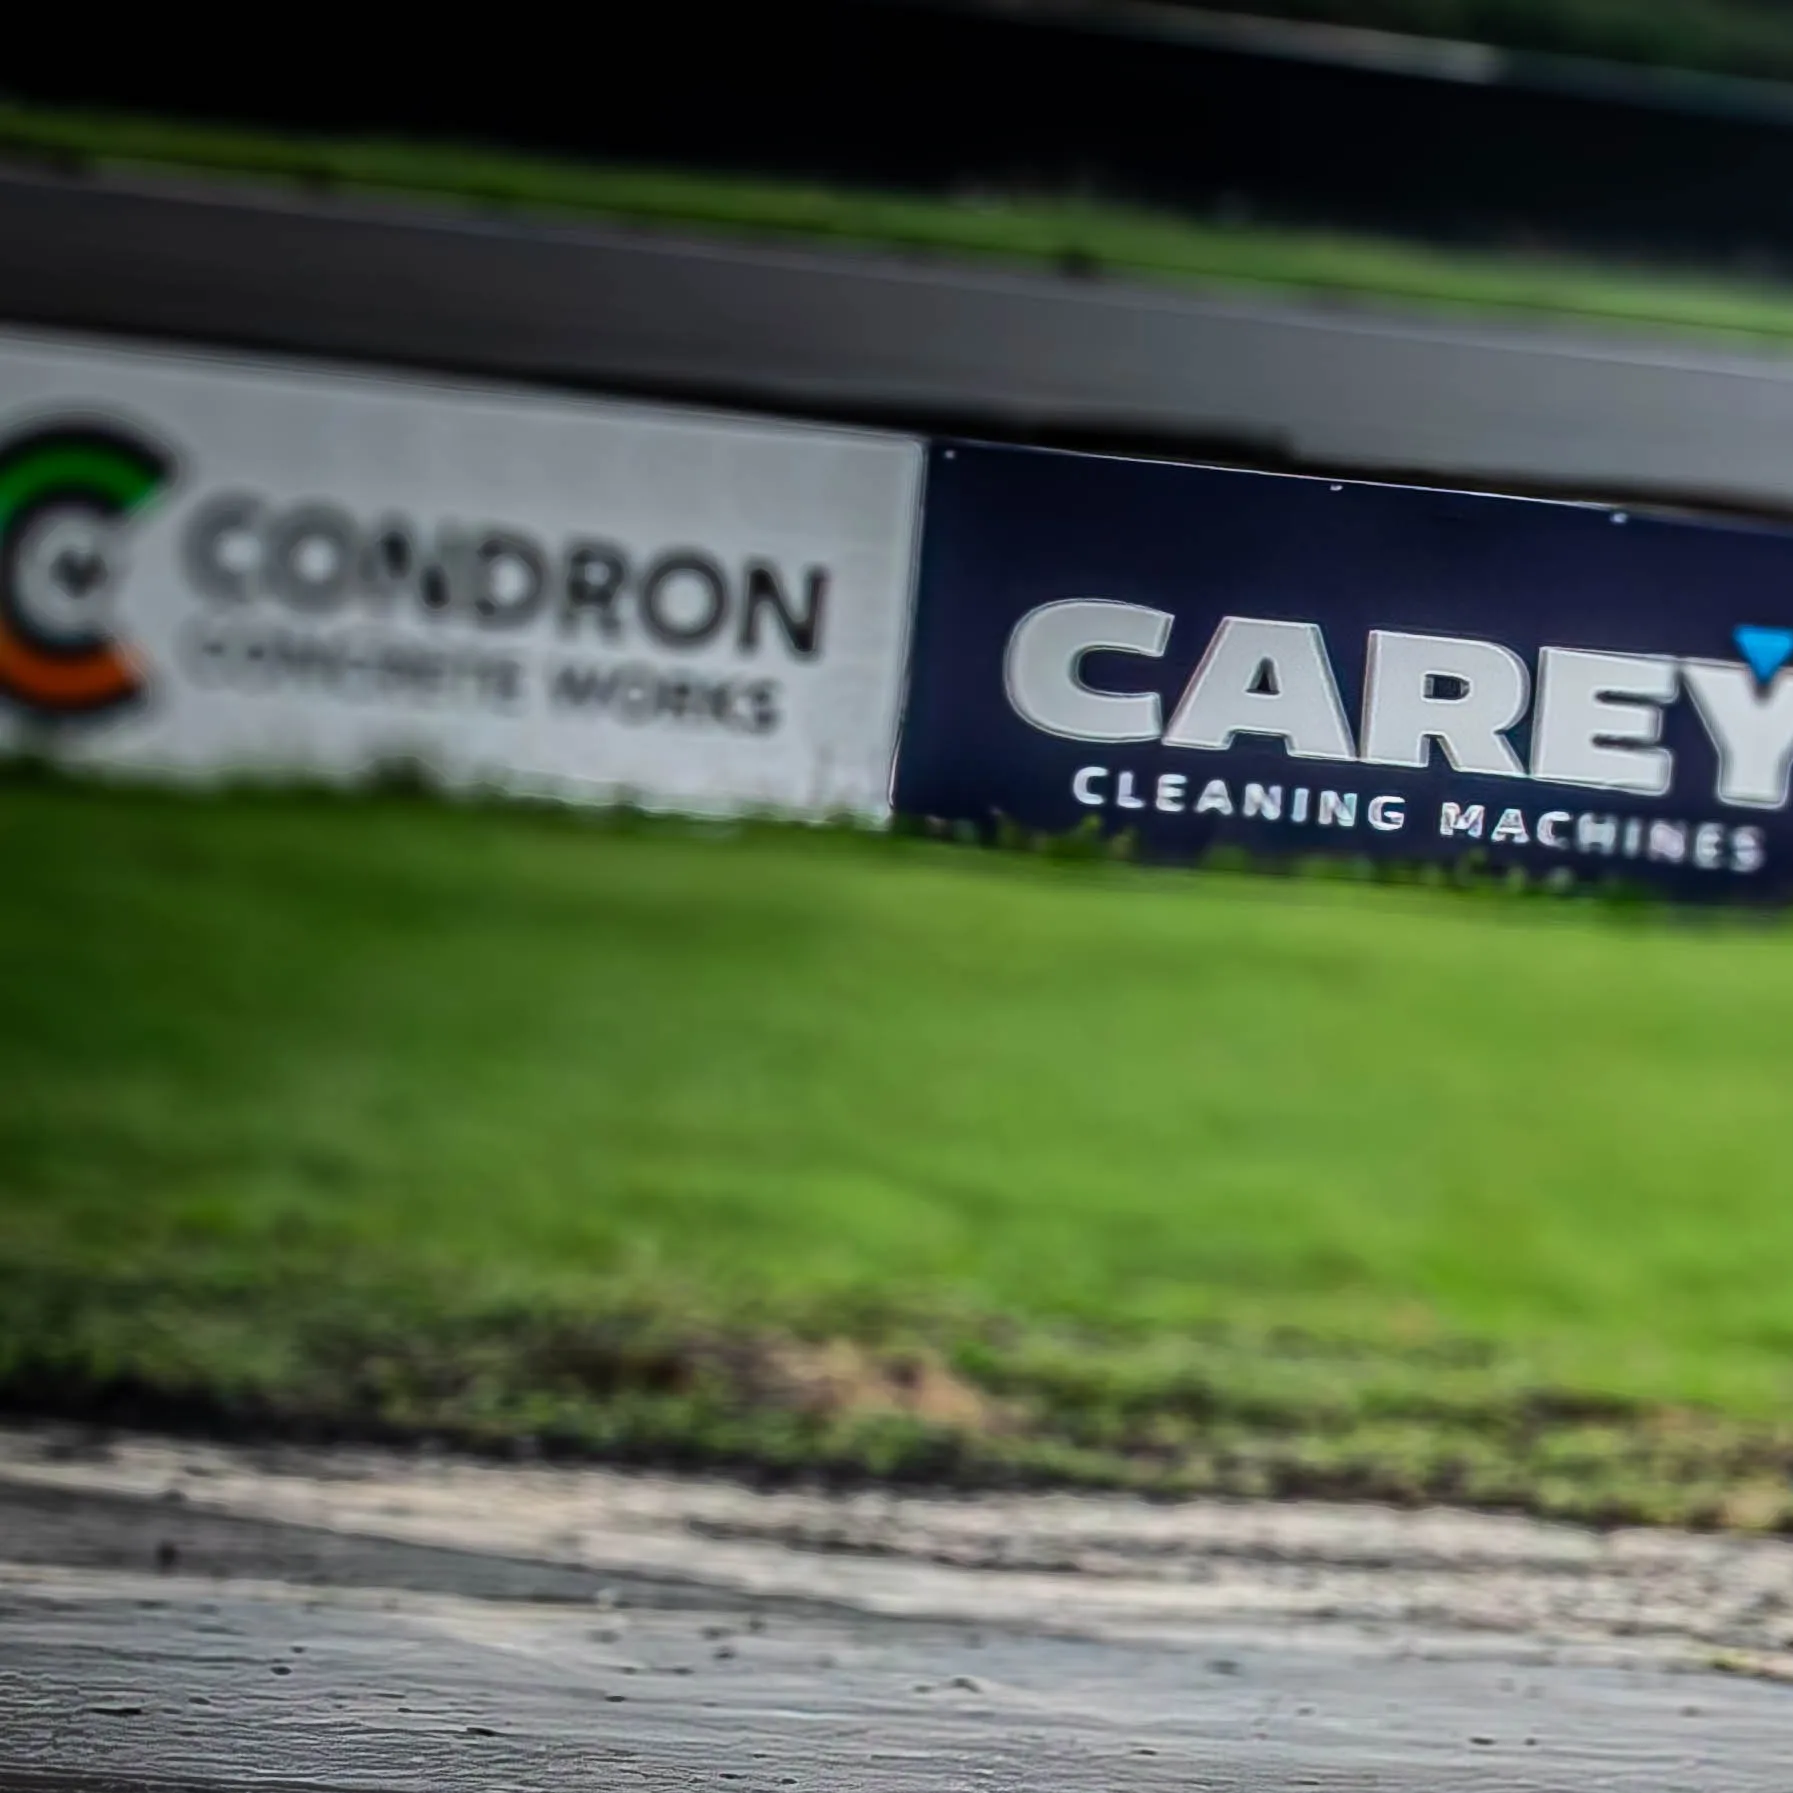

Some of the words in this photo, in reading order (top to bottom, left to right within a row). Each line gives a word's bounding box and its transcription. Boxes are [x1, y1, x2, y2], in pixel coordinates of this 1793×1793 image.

[183, 490, 830, 662] CONDRON
[550, 658, 785, 740] WORKS
[1071, 766, 1406, 832] CLEANING
[1439, 801, 1768, 875] MACHINES
